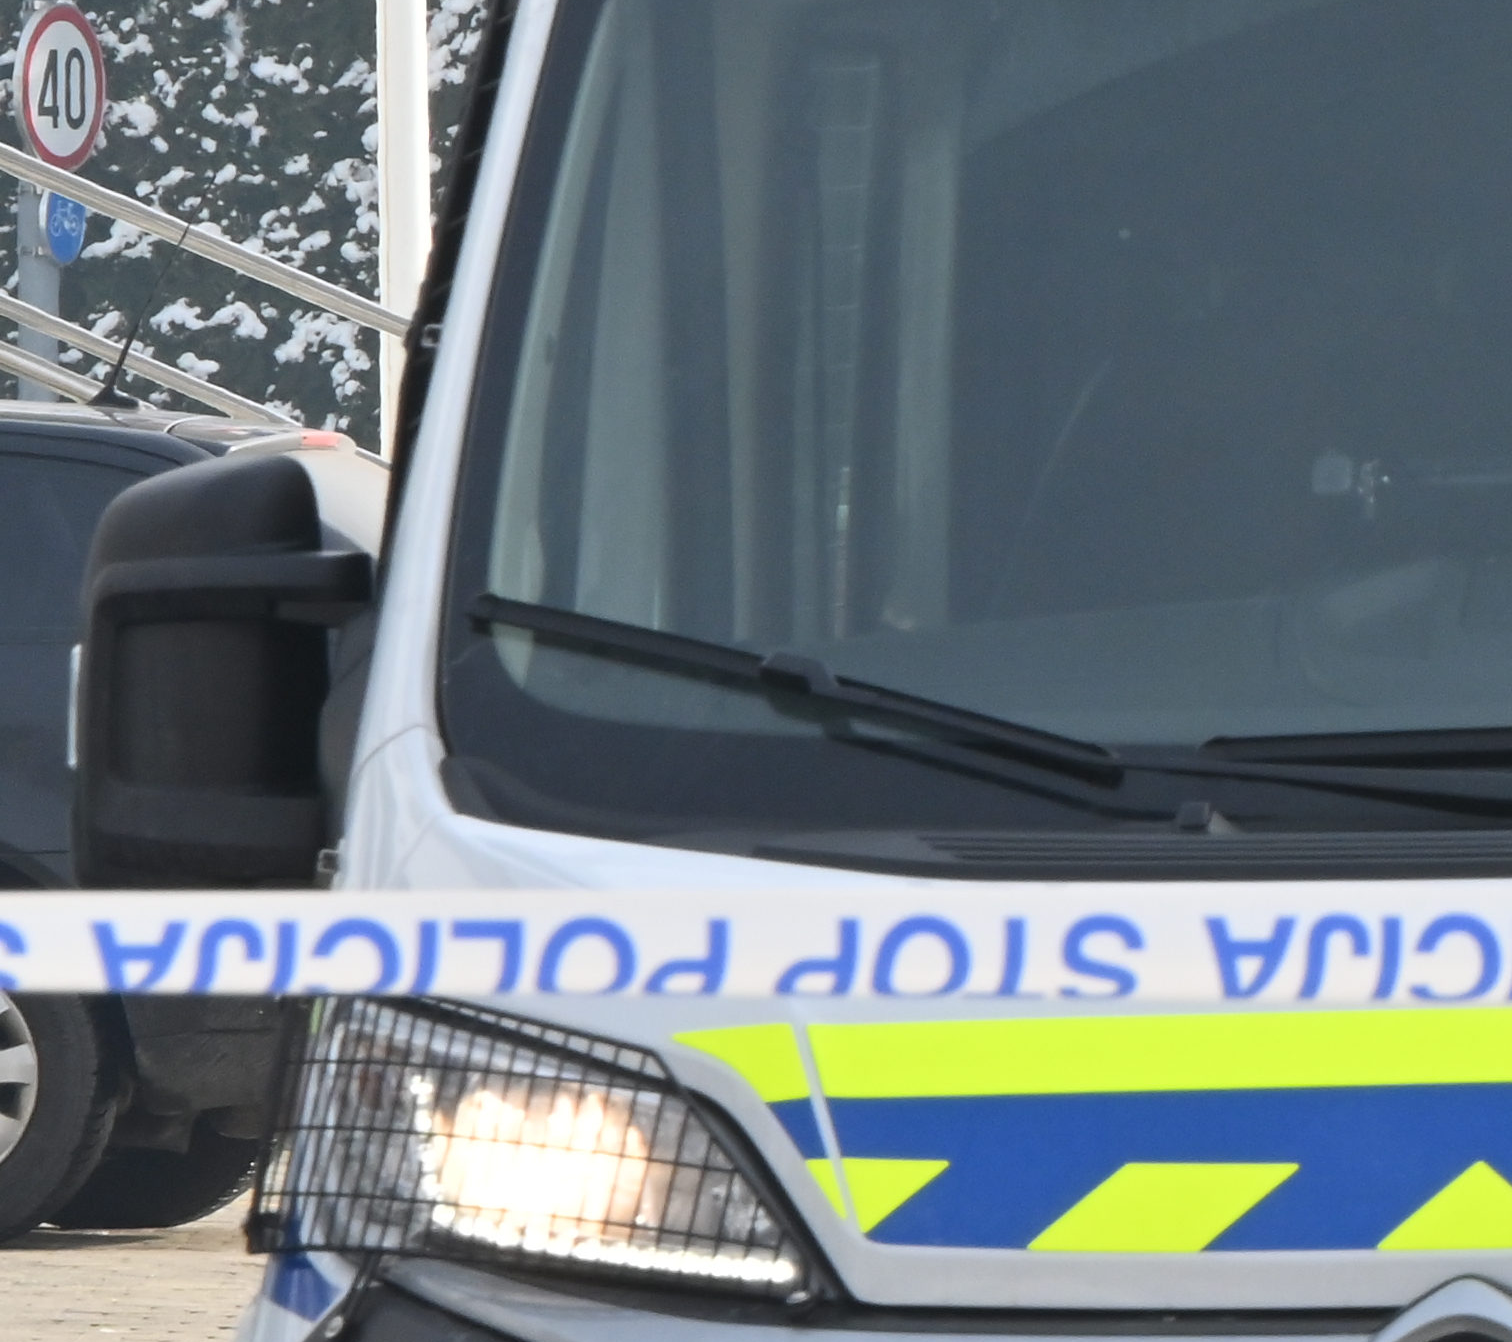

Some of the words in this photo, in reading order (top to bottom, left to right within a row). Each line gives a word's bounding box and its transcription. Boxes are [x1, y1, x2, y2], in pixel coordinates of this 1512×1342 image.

[37, 47, 87, 131] 40
[93, 916, 731, 997] POLICIJA
[775, 913, 1145, 1000] STOP
